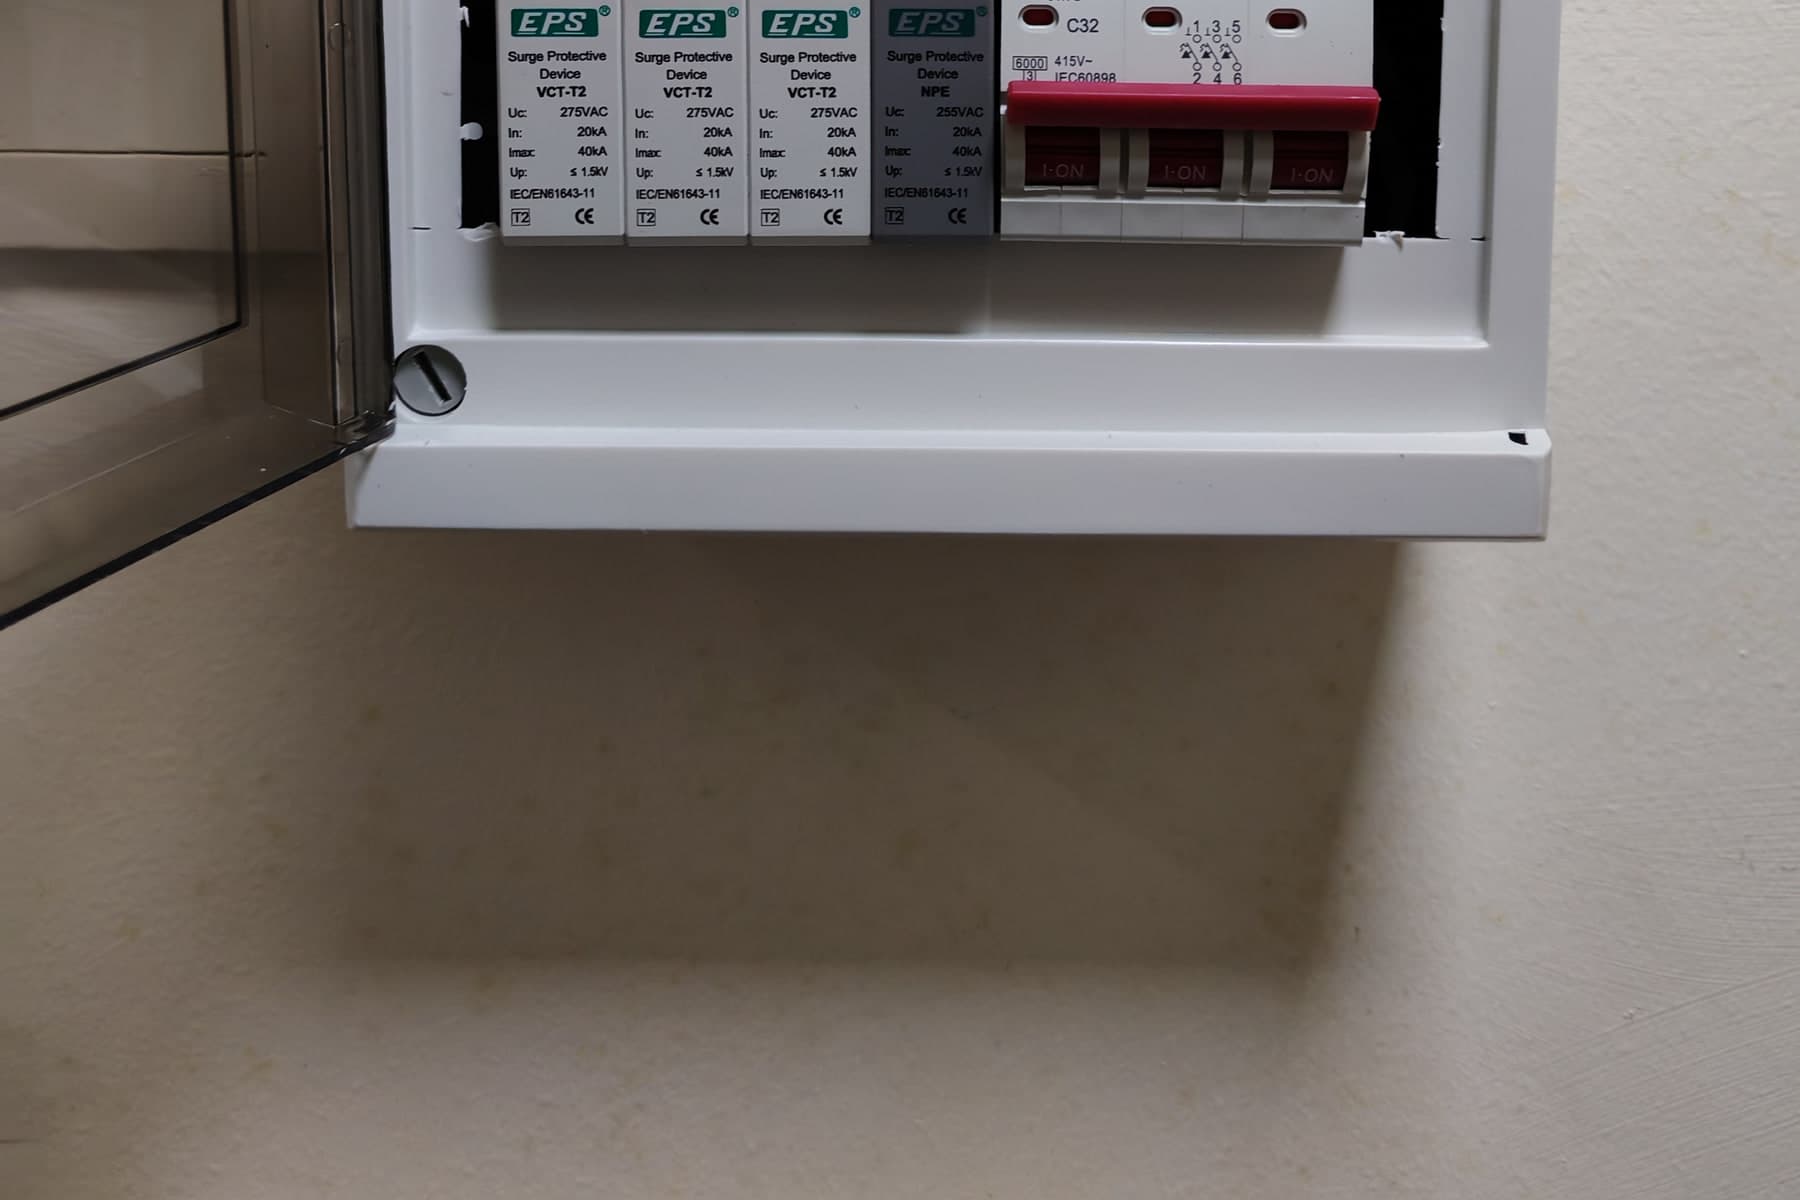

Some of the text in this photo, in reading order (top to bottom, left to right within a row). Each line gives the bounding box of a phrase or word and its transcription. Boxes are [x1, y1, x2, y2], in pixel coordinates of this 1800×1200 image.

[518, 12, 587, 34] EPS
[646, 13, 715, 36] EPS
[768, 13, 837, 36] EPS
[894, 12, 963, 34] EPS
[1067, 18, 1099, 33] C32
[1193, 21, 1241, 33] 1 3 5
[508, 51, 607, 64] Surge Protective
[635, 52, 733, 64] Surge Protective
[760, 52, 857, 65] Surge Protective
[887, 51, 984, 64] Surge Protective
[1015, 58, 1045, 68] 6000
[540, 69, 581, 79] Device
[666, 70, 707, 80] Device
[791, 70, 831, 80] Device
[918, 69, 958, 79] Device
[1193, 72, 1242, 85] 2 4 6
[537, 86, 586, 97] VCT-T2
[664, 87, 712, 98] VCT-T2
[788, 88, 836, 98] VCT-T2
[921, 87, 950, 97] NPE
[508, 107, 608, 118] Uc: 275VAC
[635, 107, 734, 118] Uc: 275VAC
[760, 107, 858, 118] Uc: 275VAC
[936, 107, 984, 118] 255VAC
[508, 127, 607, 138] In: 20kA
[635, 128, 732, 138] In: 20kA
[760, 128, 856, 138] In: 20kA
[953, 127, 982, 137] 20kA
[577, 147, 607, 156] 40kA
[704, 147, 733, 156] 40kA
[827, 147, 856, 157] 40kA
[952, 147, 982, 156] 40kA
[510, 167, 527, 178] Up:
[582, 167, 608, 177] 1.5kV
[636, 168, 653, 179] Up:
[708, 167, 734, 177] 1.5kV
[760, 168, 777, 179] Up:
[831, 167, 857, 177] 1.5kV
[510, 189, 594, 199] IEC/EN61643-11
[636, 189, 720, 199] IEC/EN61643-11
[760, 189, 843, 199] IEC/EN61643-11
[513, 212, 529, 222] T2
[575, 208, 594, 224] CE
[639, 212, 655, 223] T2
[700, 209, 719, 225] CE
[763, 212, 779, 223] T2
[824, 209, 843, 225] CE
[886, 210, 903, 222] T2
